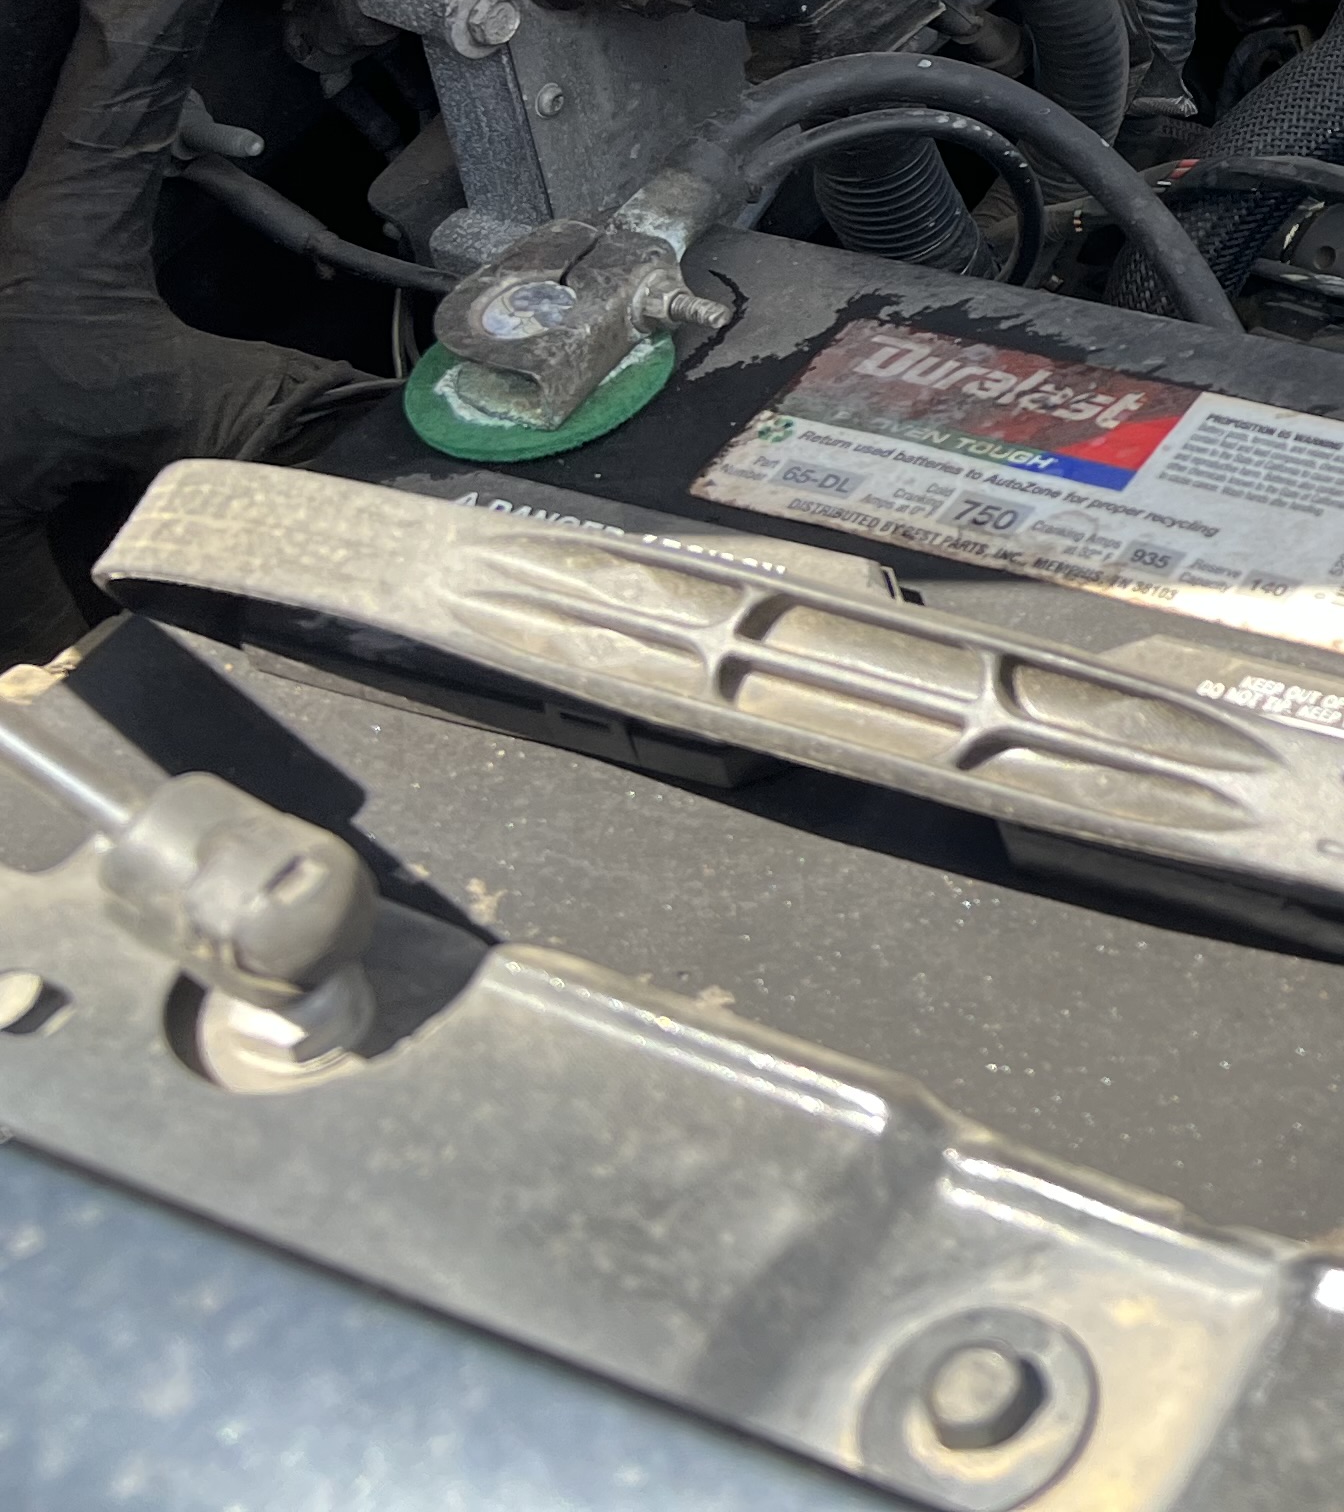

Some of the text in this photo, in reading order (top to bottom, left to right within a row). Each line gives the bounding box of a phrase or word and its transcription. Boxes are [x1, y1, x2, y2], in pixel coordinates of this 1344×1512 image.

[1205, 413, 1278, 437] PROPOSITION
[1276, 428, 1293, 440] 65
[953, 437, 1055, 470] TOUGH
[782, 465, 851, 494] 65-DL
[799, 429, 1220, 539] Return used batteries to AutoZone for proper recycling
[893, 487, 945, 511] Cranking
[953, 498, 1020, 531] 750
[786, 498, 881, 530] DISTRIBUTED
[878, 520, 906, 537] BY
[940, 534, 990, 561] PARTS,
[1132, 580, 1179, 600] 38103
[1129, 548, 1172, 570] 935
[1250, 579, 1290, 597] 140
[1196, 679, 1225, 700] DO
[1223, 686, 1264, 710] NOT
[1295, 703, 1343, 724] KEEP
[1239, 675, 1286, 697] KEEP
[1283, 685, 1323, 705] OUT
